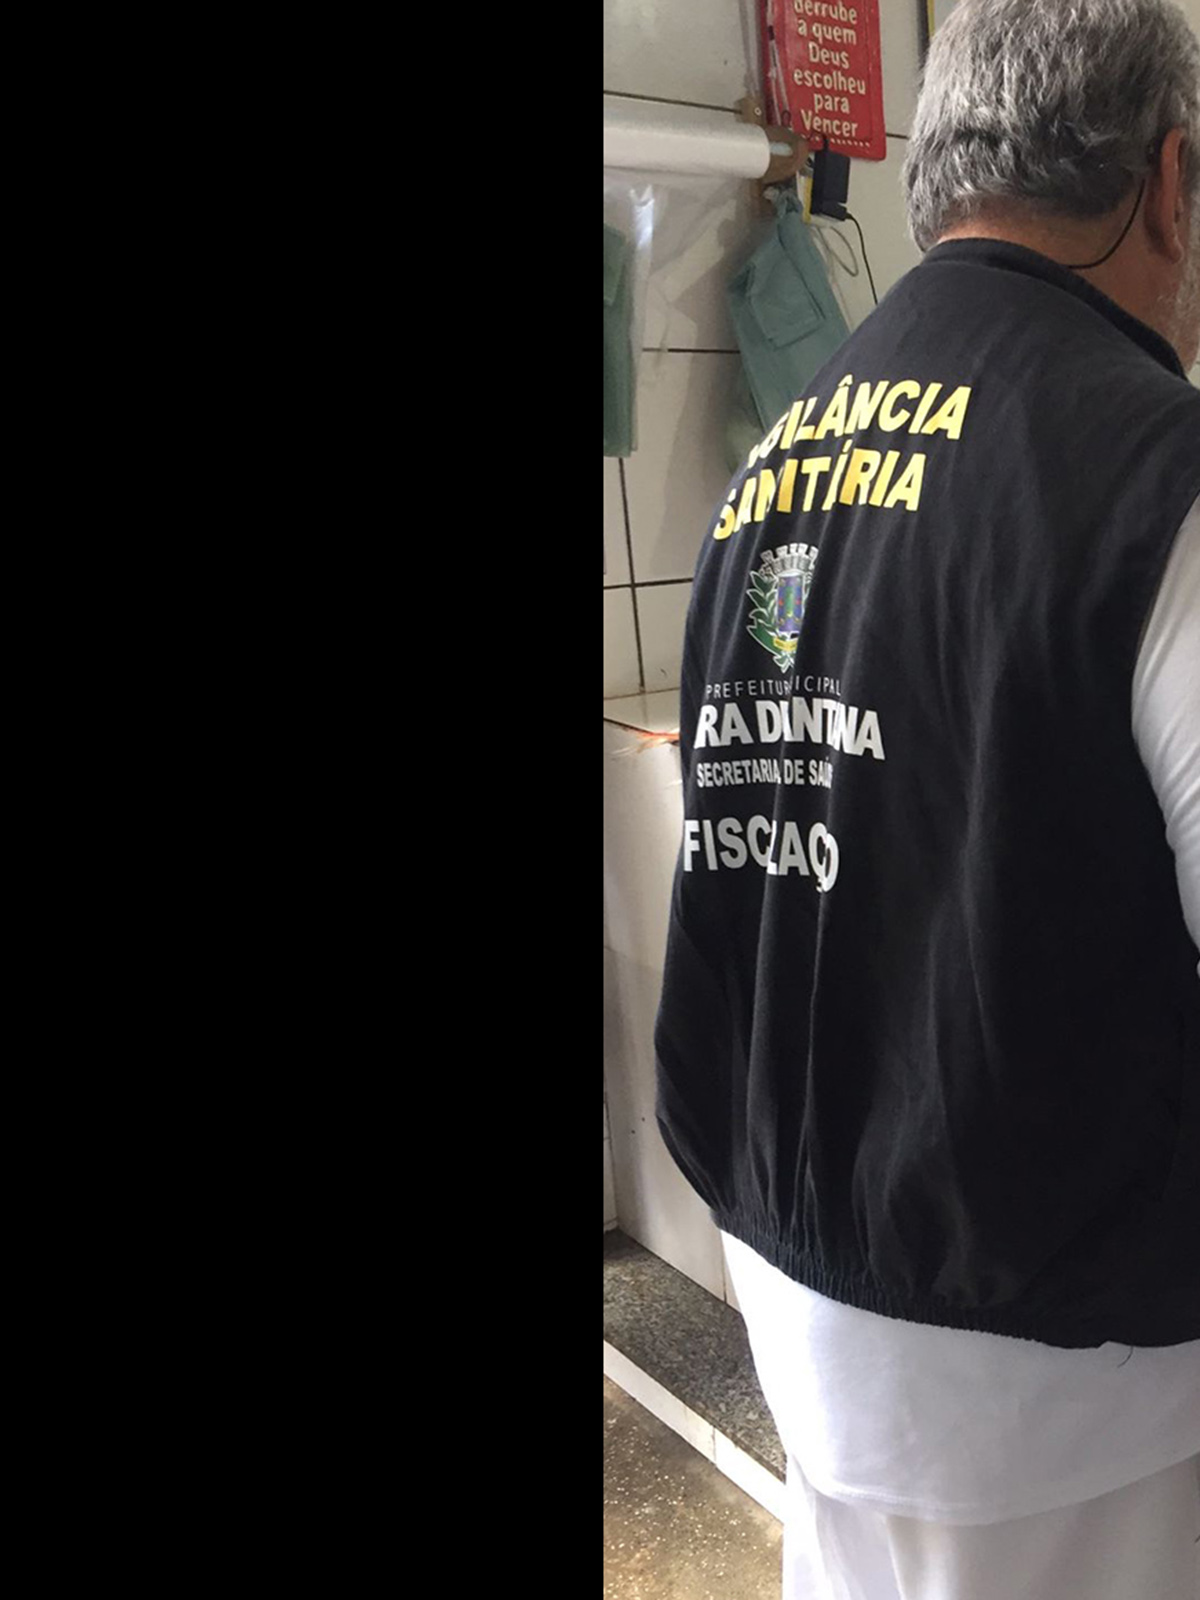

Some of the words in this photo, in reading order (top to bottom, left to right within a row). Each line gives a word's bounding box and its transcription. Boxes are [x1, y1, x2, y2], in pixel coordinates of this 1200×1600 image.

[798, 19, 807, 36] a
[812, 22, 857, 45] quem
[808, 41, 850, 69] Deus
[793, 68, 867, 95] escolheu
[814, 93, 850, 114] para
[801, 108, 858, 137] Vencer
[697, 758, 782, 788] SECRETARIA
[783, 758, 805, 785] DE
